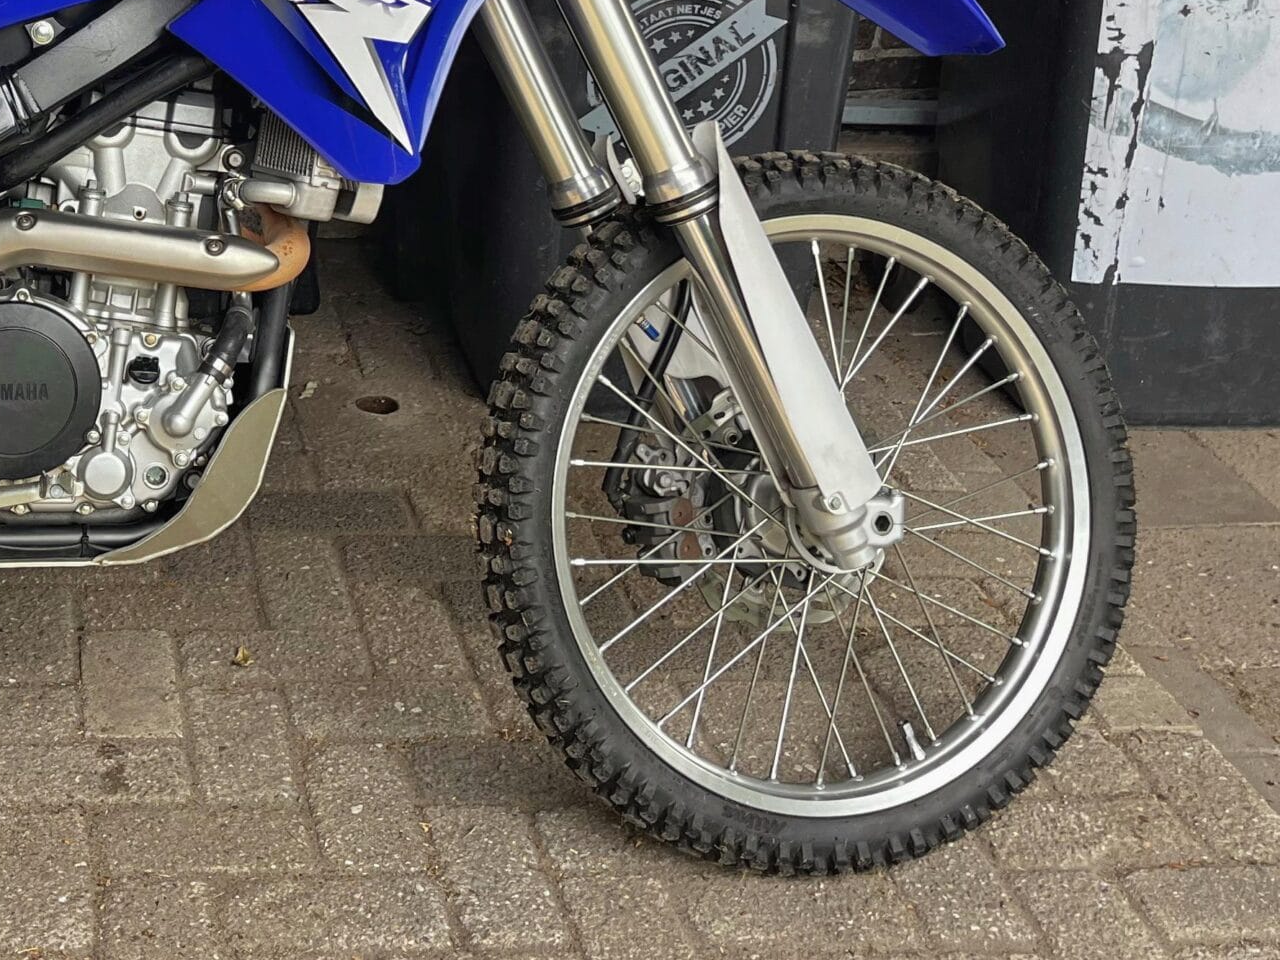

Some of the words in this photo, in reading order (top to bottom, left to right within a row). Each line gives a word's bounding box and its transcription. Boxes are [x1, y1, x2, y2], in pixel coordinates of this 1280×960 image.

[676, 4, 723, 20] NETJES
[663, 20, 757, 93] GINAL
[719, 104, 748, 135] PIER
